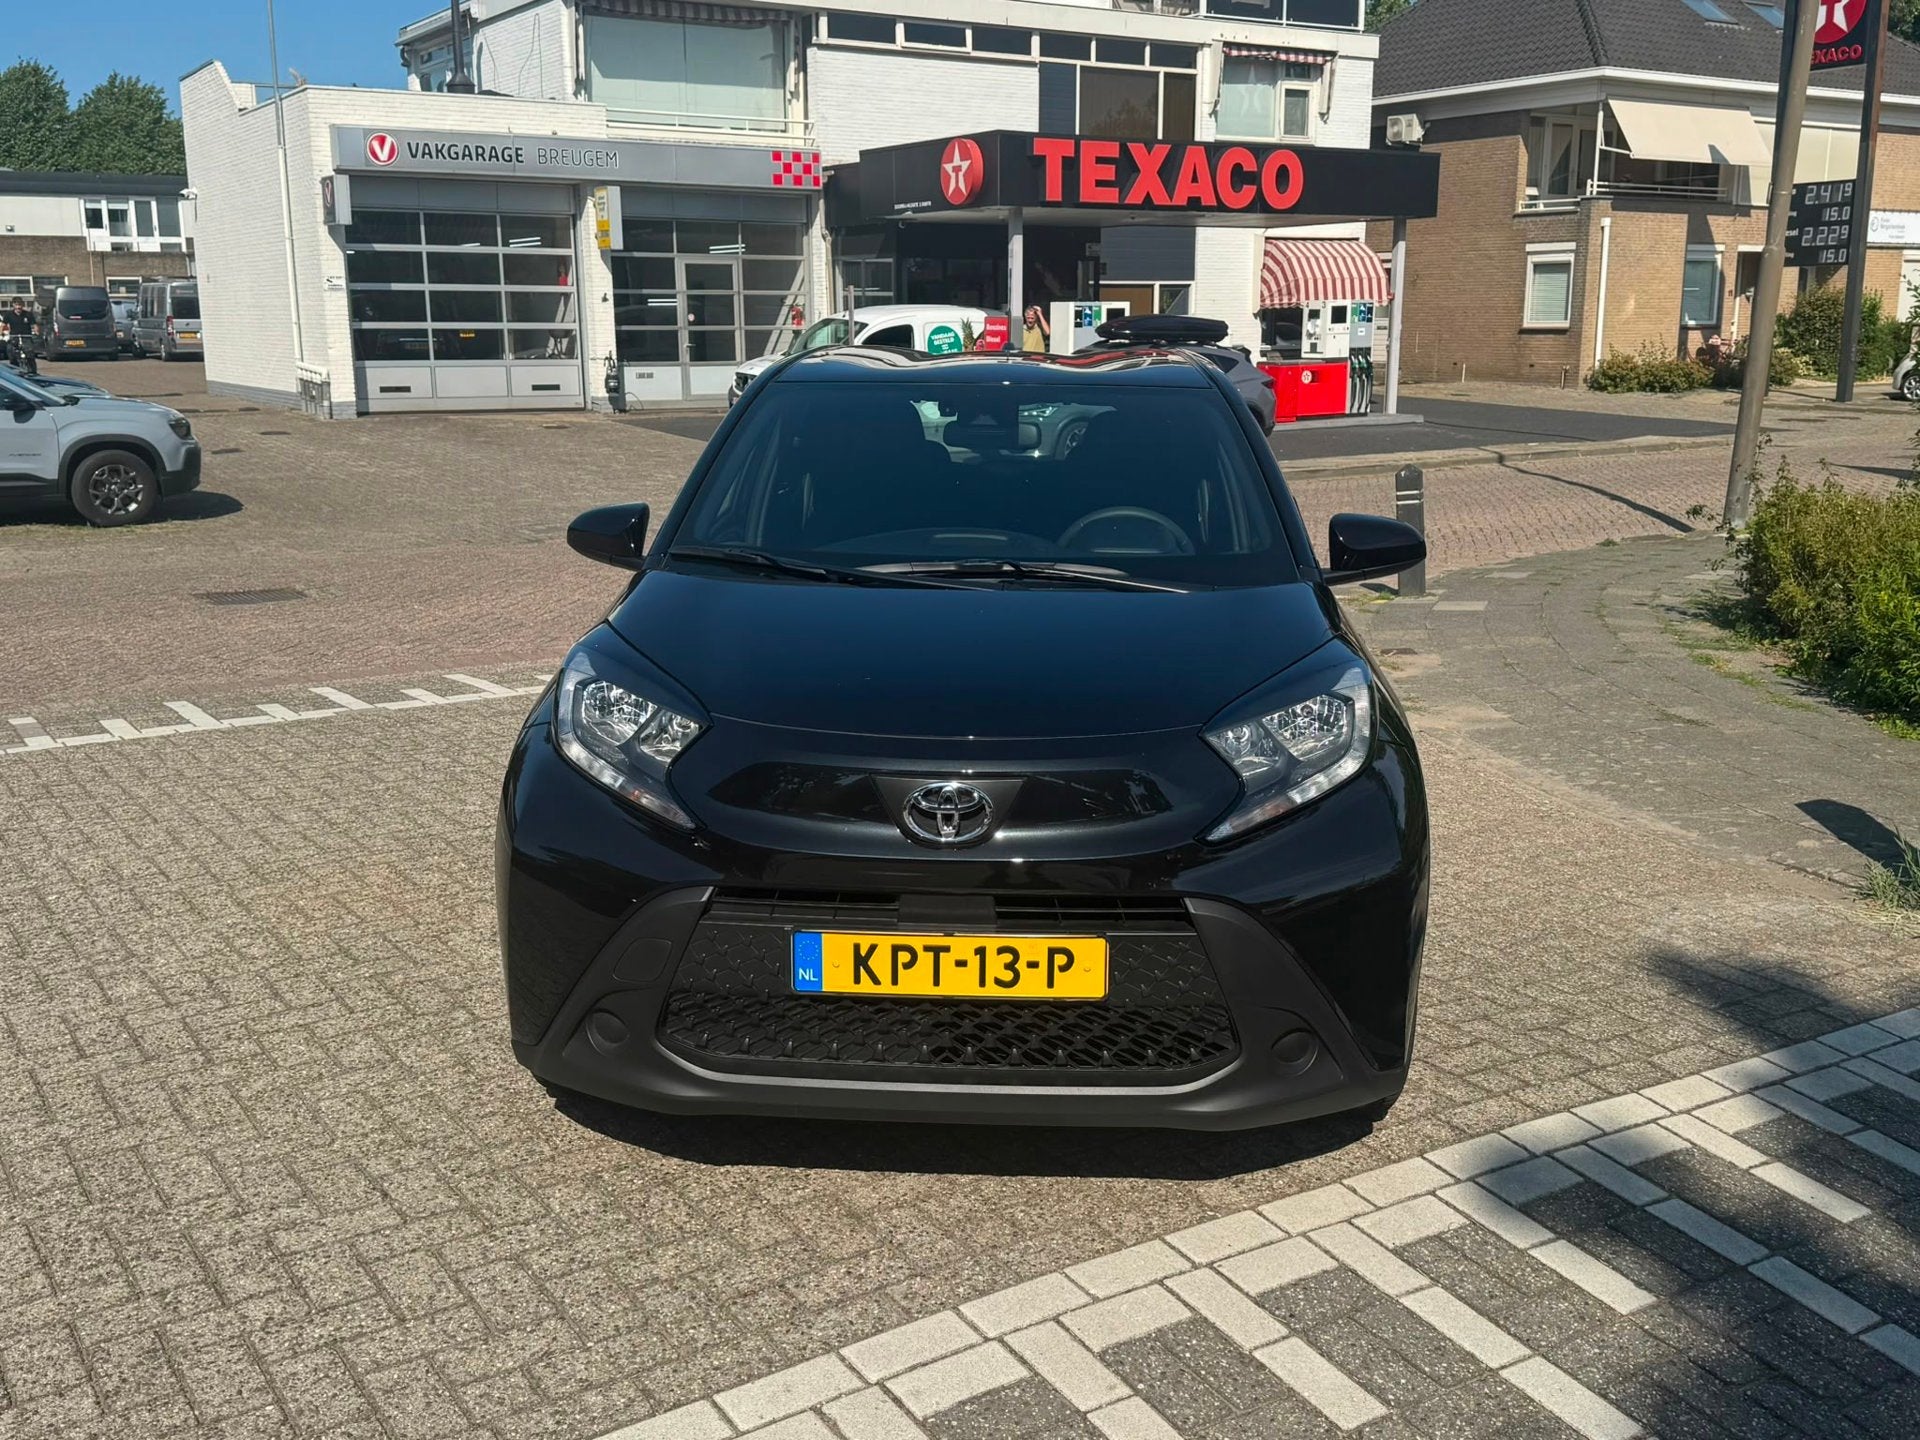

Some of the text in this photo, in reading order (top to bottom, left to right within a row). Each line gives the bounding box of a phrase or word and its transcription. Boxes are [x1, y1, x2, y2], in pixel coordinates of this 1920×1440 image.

[1811, 45, 1862, 65] XACO
[407, 141, 619, 168] VAKGARAGE BREUGEM
[1033, 137, 1304, 210] TEXACO
[1825, 206, 1851, 221] 15.0
[1785, 225, 1849, 247] esel 2.229
[1820, 248, 1847, 263] 15.0
[798, 967, 819, 981] NL
[853, 942, 1075, 989] KPT-13-P
